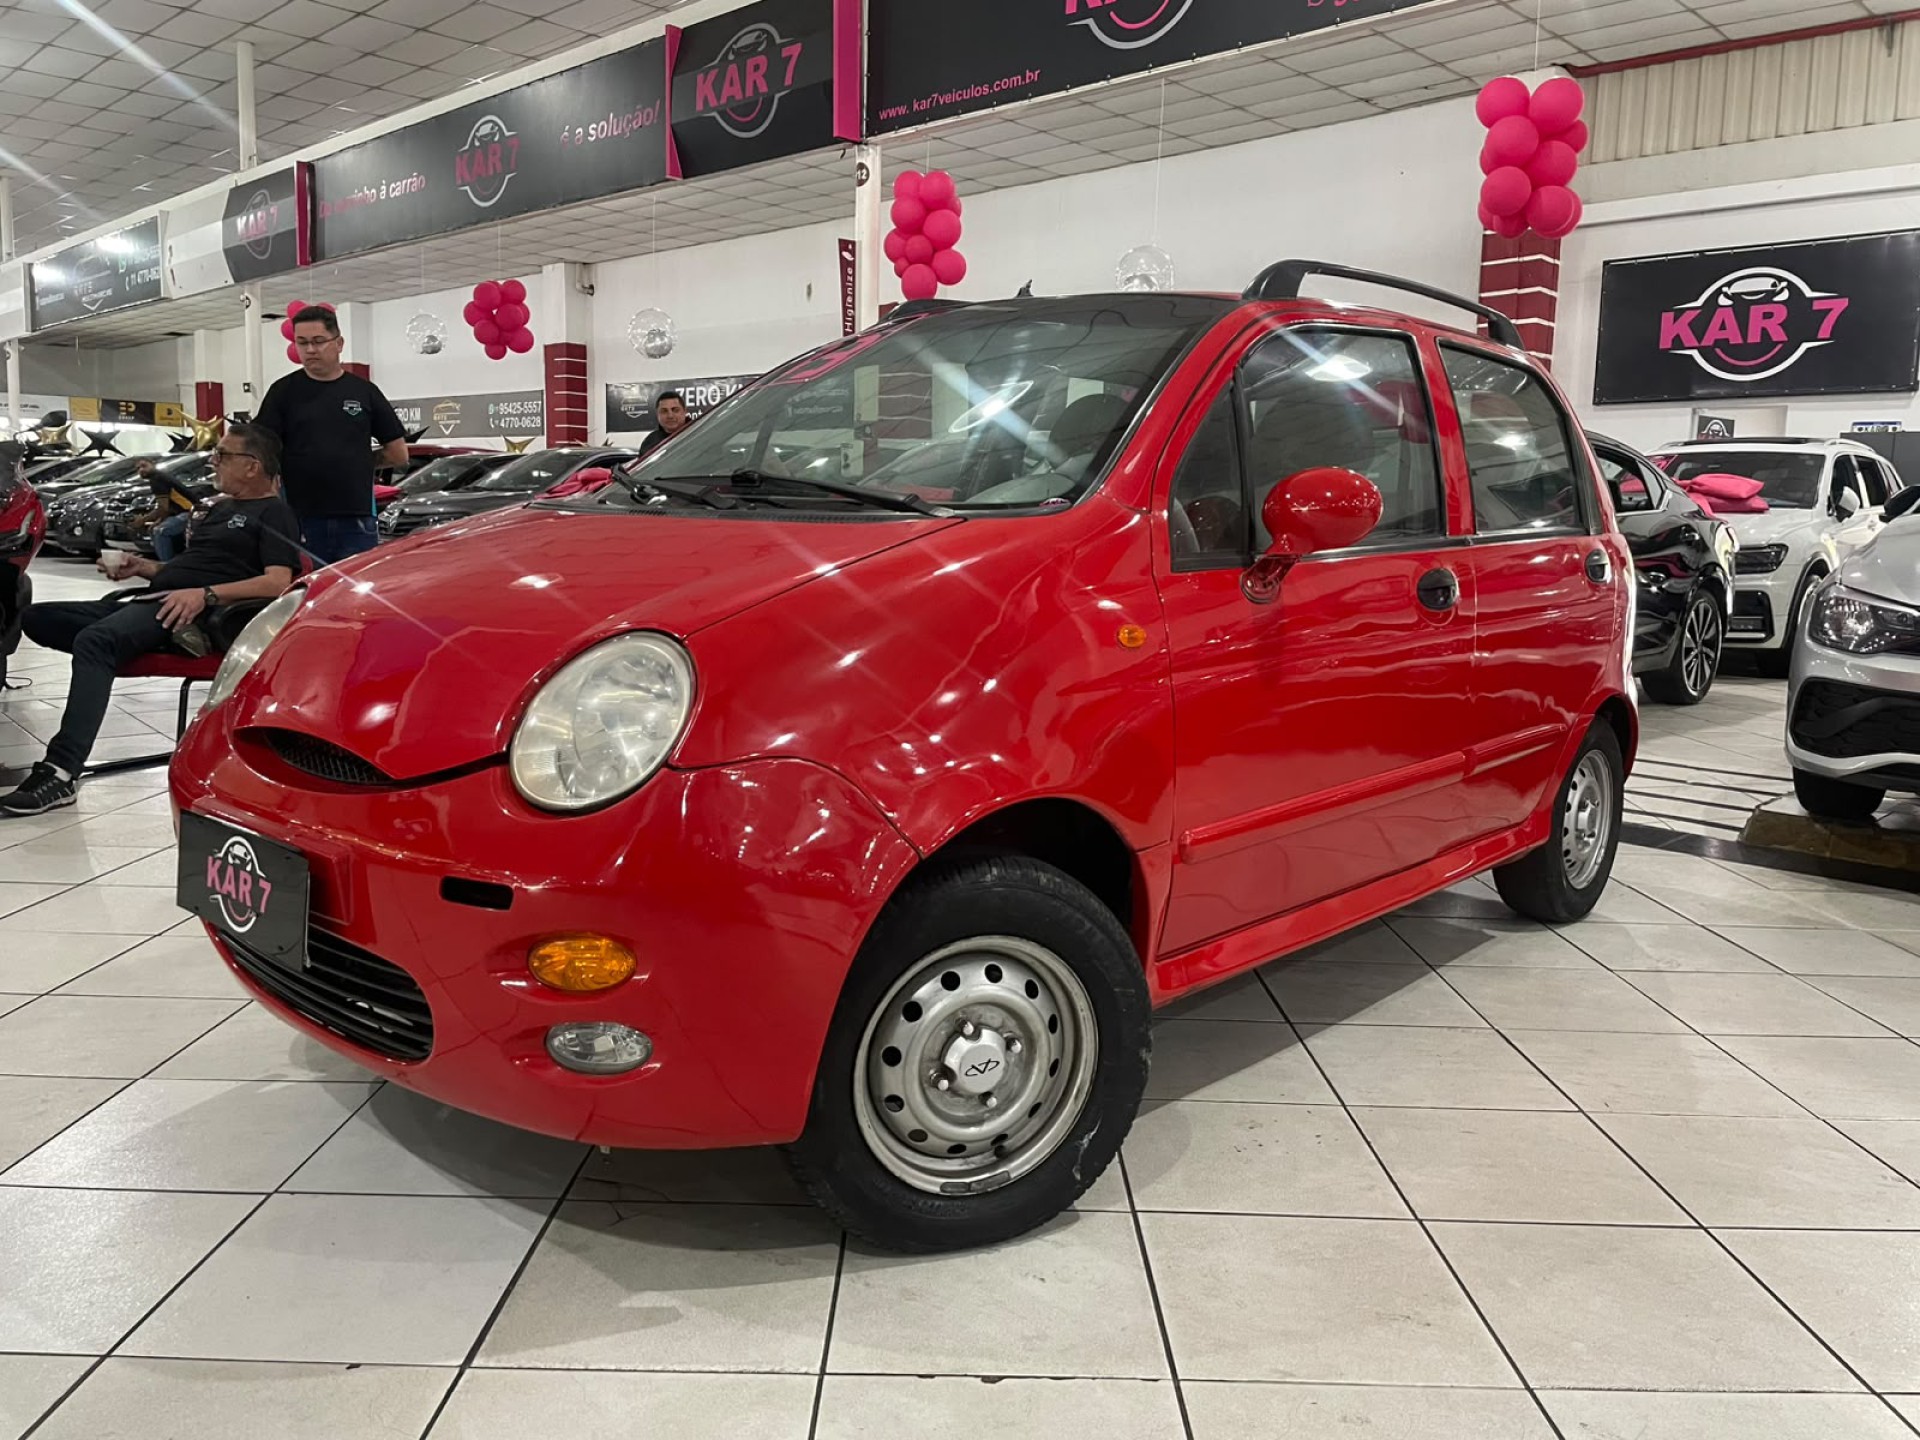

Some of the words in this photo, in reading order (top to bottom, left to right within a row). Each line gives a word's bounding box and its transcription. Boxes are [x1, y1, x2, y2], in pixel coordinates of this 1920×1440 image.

[695, 54, 769, 112] KAR
[781, 42, 802, 87] 7
[879, 104, 909, 120] www.
[912, 70, 1041, 112] kar7veiculos.com.br
[574, 127, 583, 145] a
[587, 98, 661, 142] solução!
[389, 172, 426, 198] carrão
[455, 143, 502, 186] KAR
[507, 138, 518, 171] 7
[1658, 302, 1789, 350] KAR
[1811, 297, 1849, 340] 7
[206, 855, 253, 907] KAR
[258, 877, 272, 914] 7
